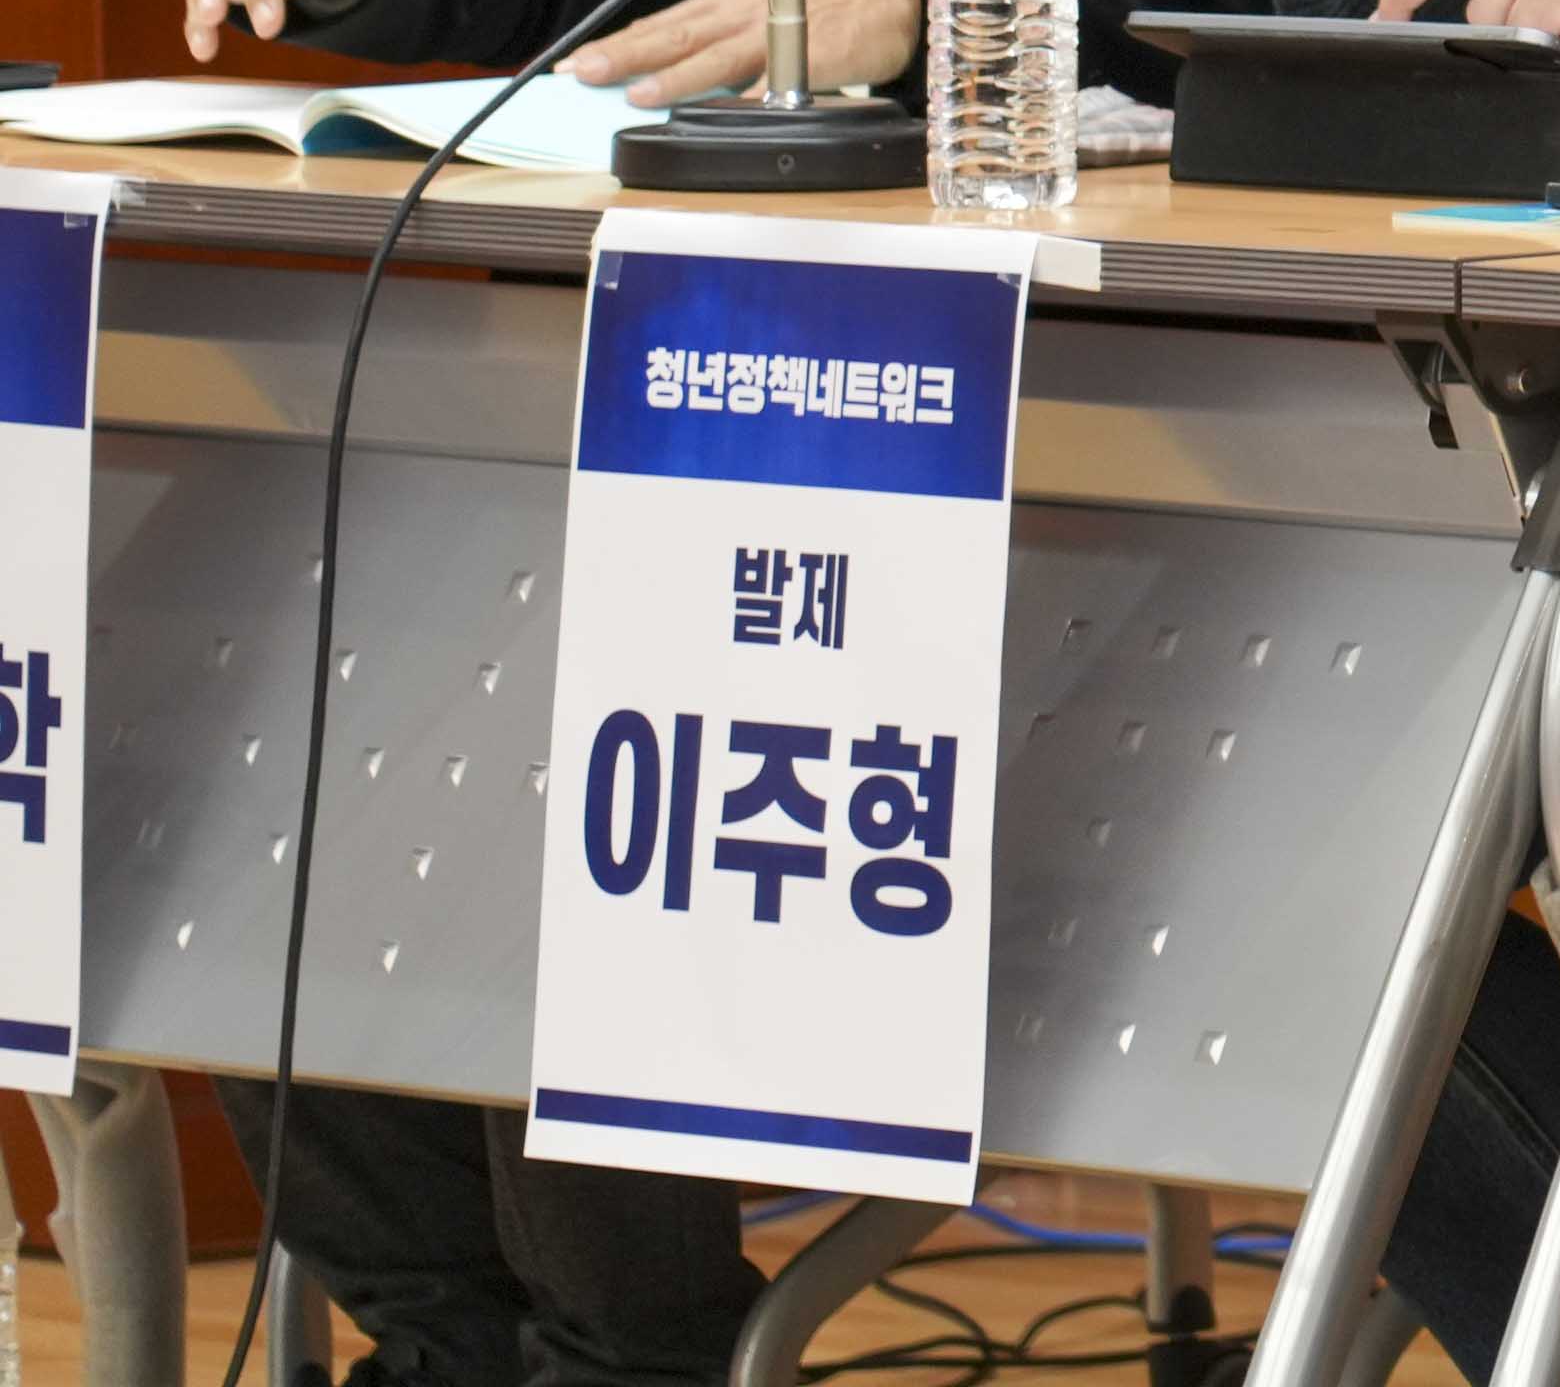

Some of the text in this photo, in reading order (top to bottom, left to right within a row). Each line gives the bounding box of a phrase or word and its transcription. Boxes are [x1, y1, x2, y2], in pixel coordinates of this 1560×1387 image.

[645, 346, 955, 424] 청년정책네트워크
[733, 547, 849, 650] 발제
[583, 709, 958, 937] 이주형
